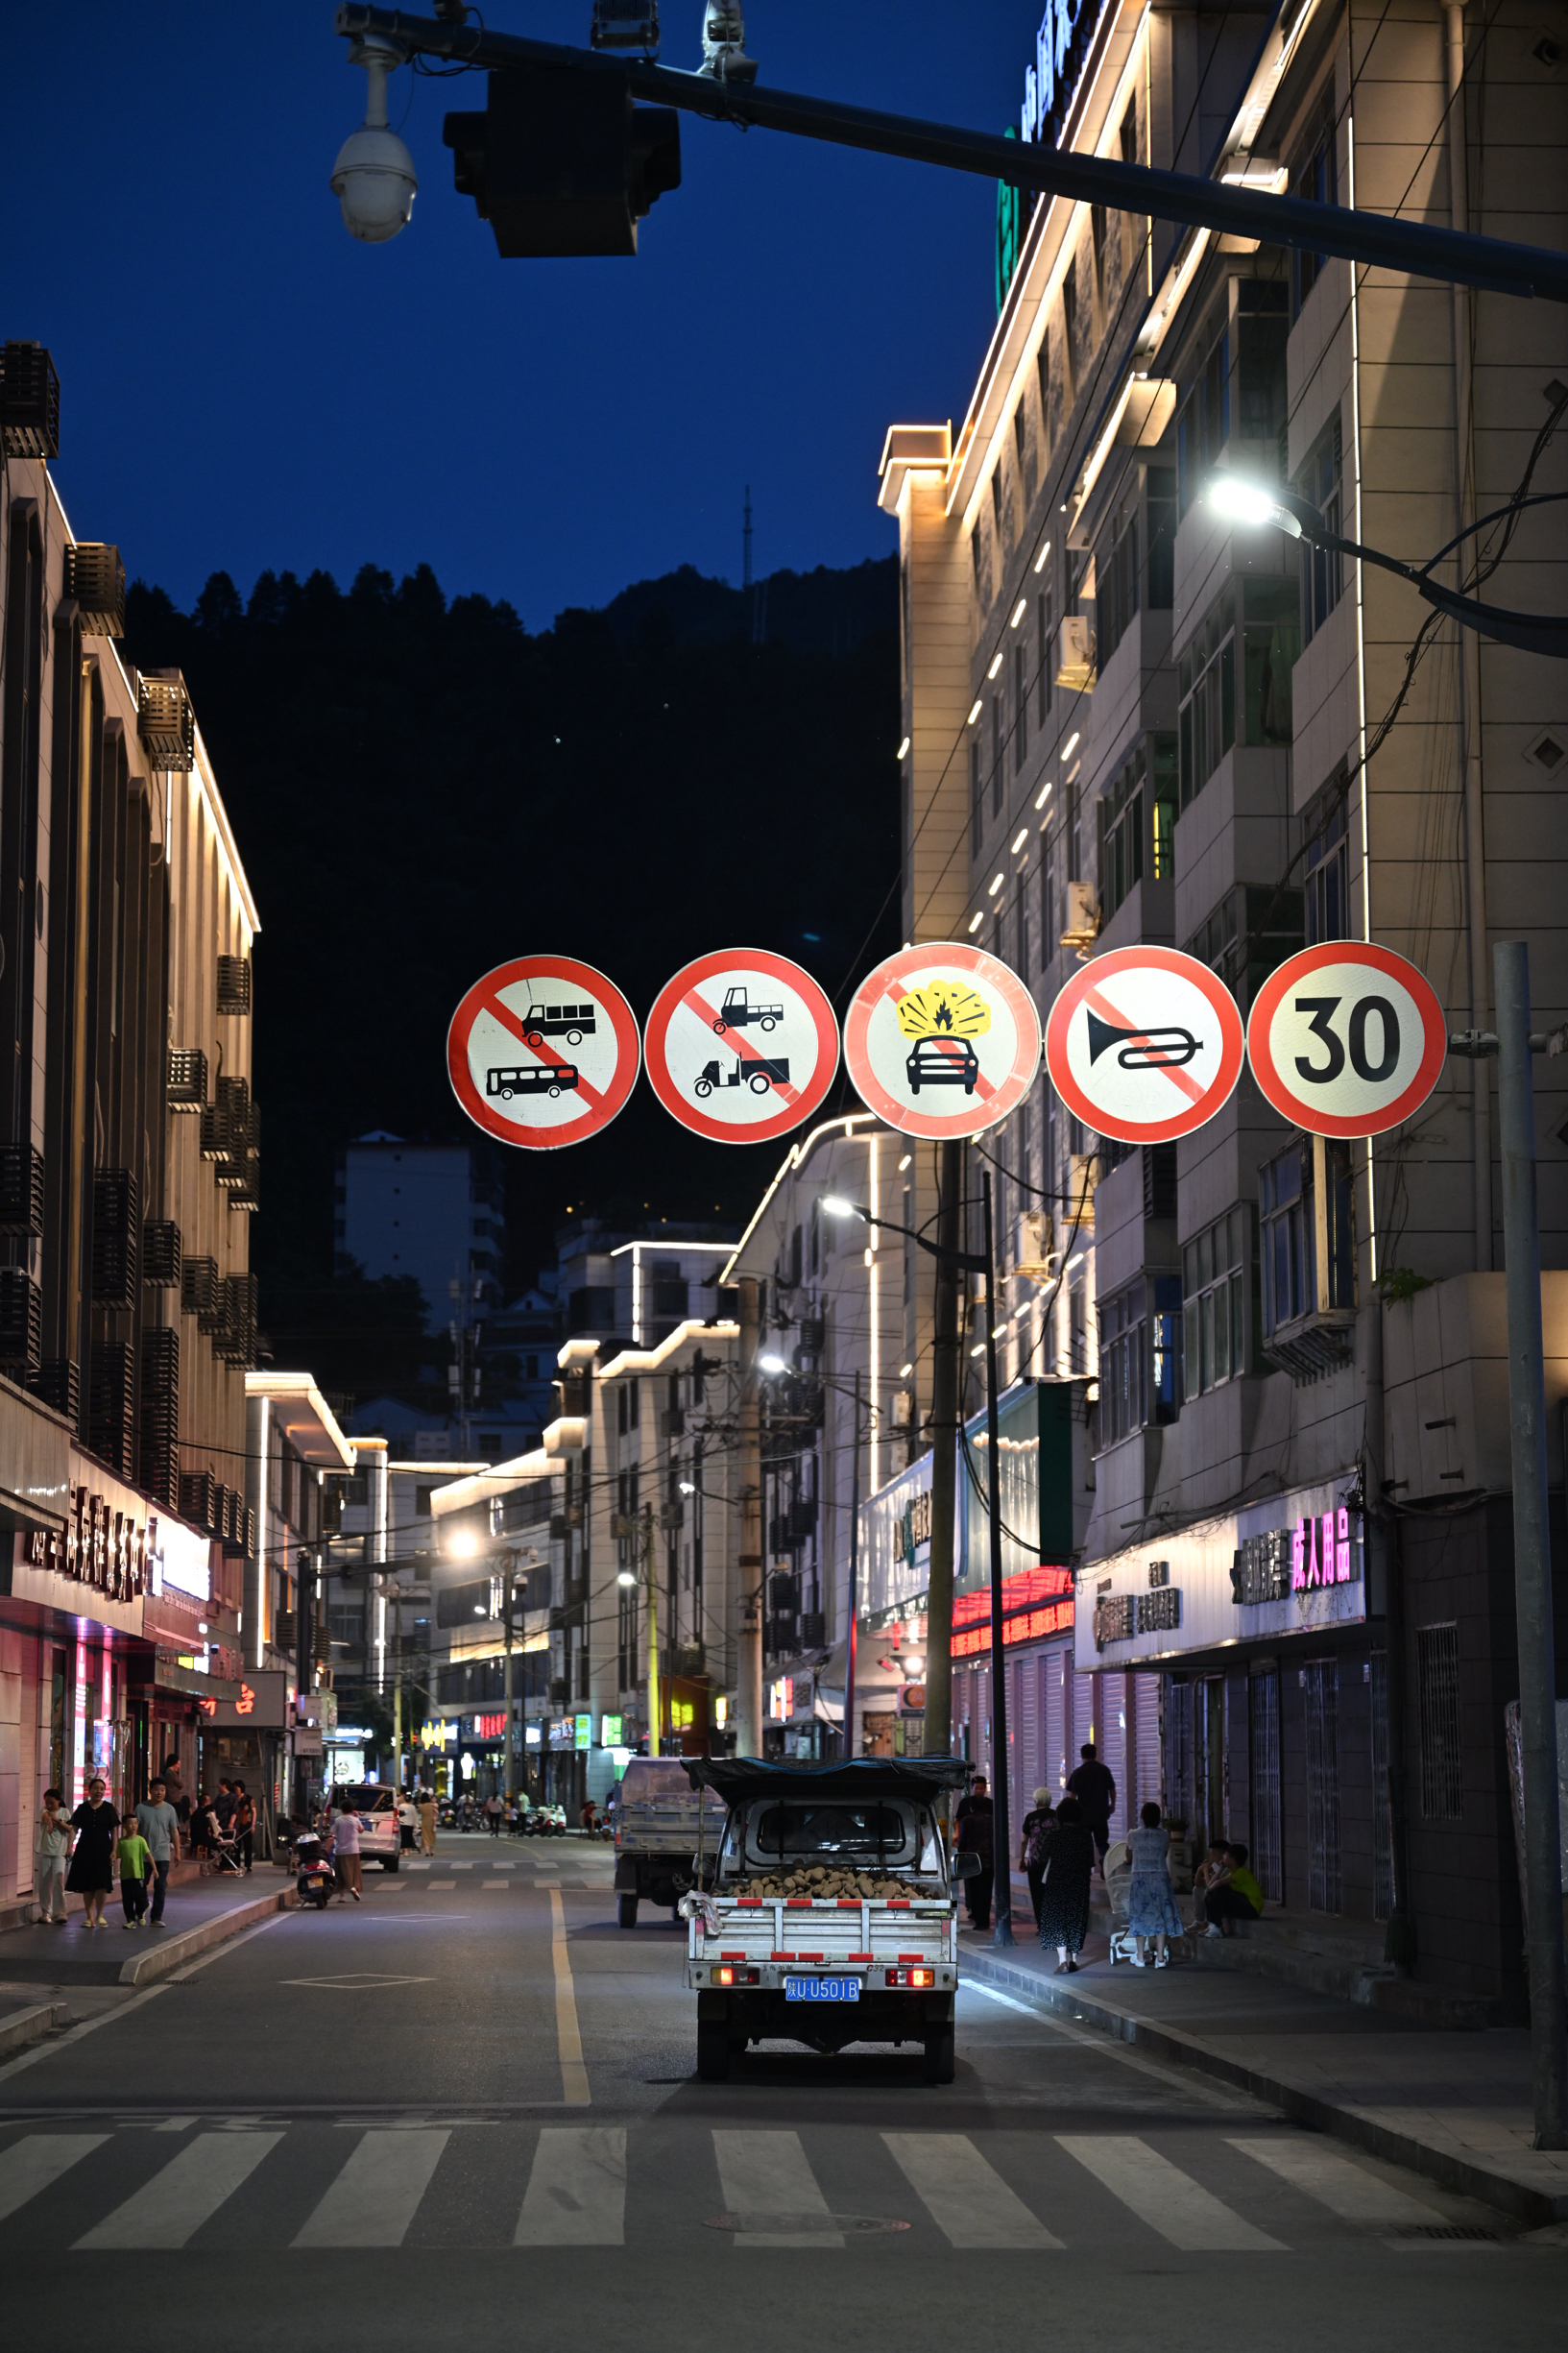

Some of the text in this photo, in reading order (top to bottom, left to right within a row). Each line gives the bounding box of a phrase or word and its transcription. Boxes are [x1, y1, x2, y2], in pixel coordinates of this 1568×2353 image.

[1294, 995, 1401, 1084] 30
[1292, 1507, 1351, 1591] 成人用品
